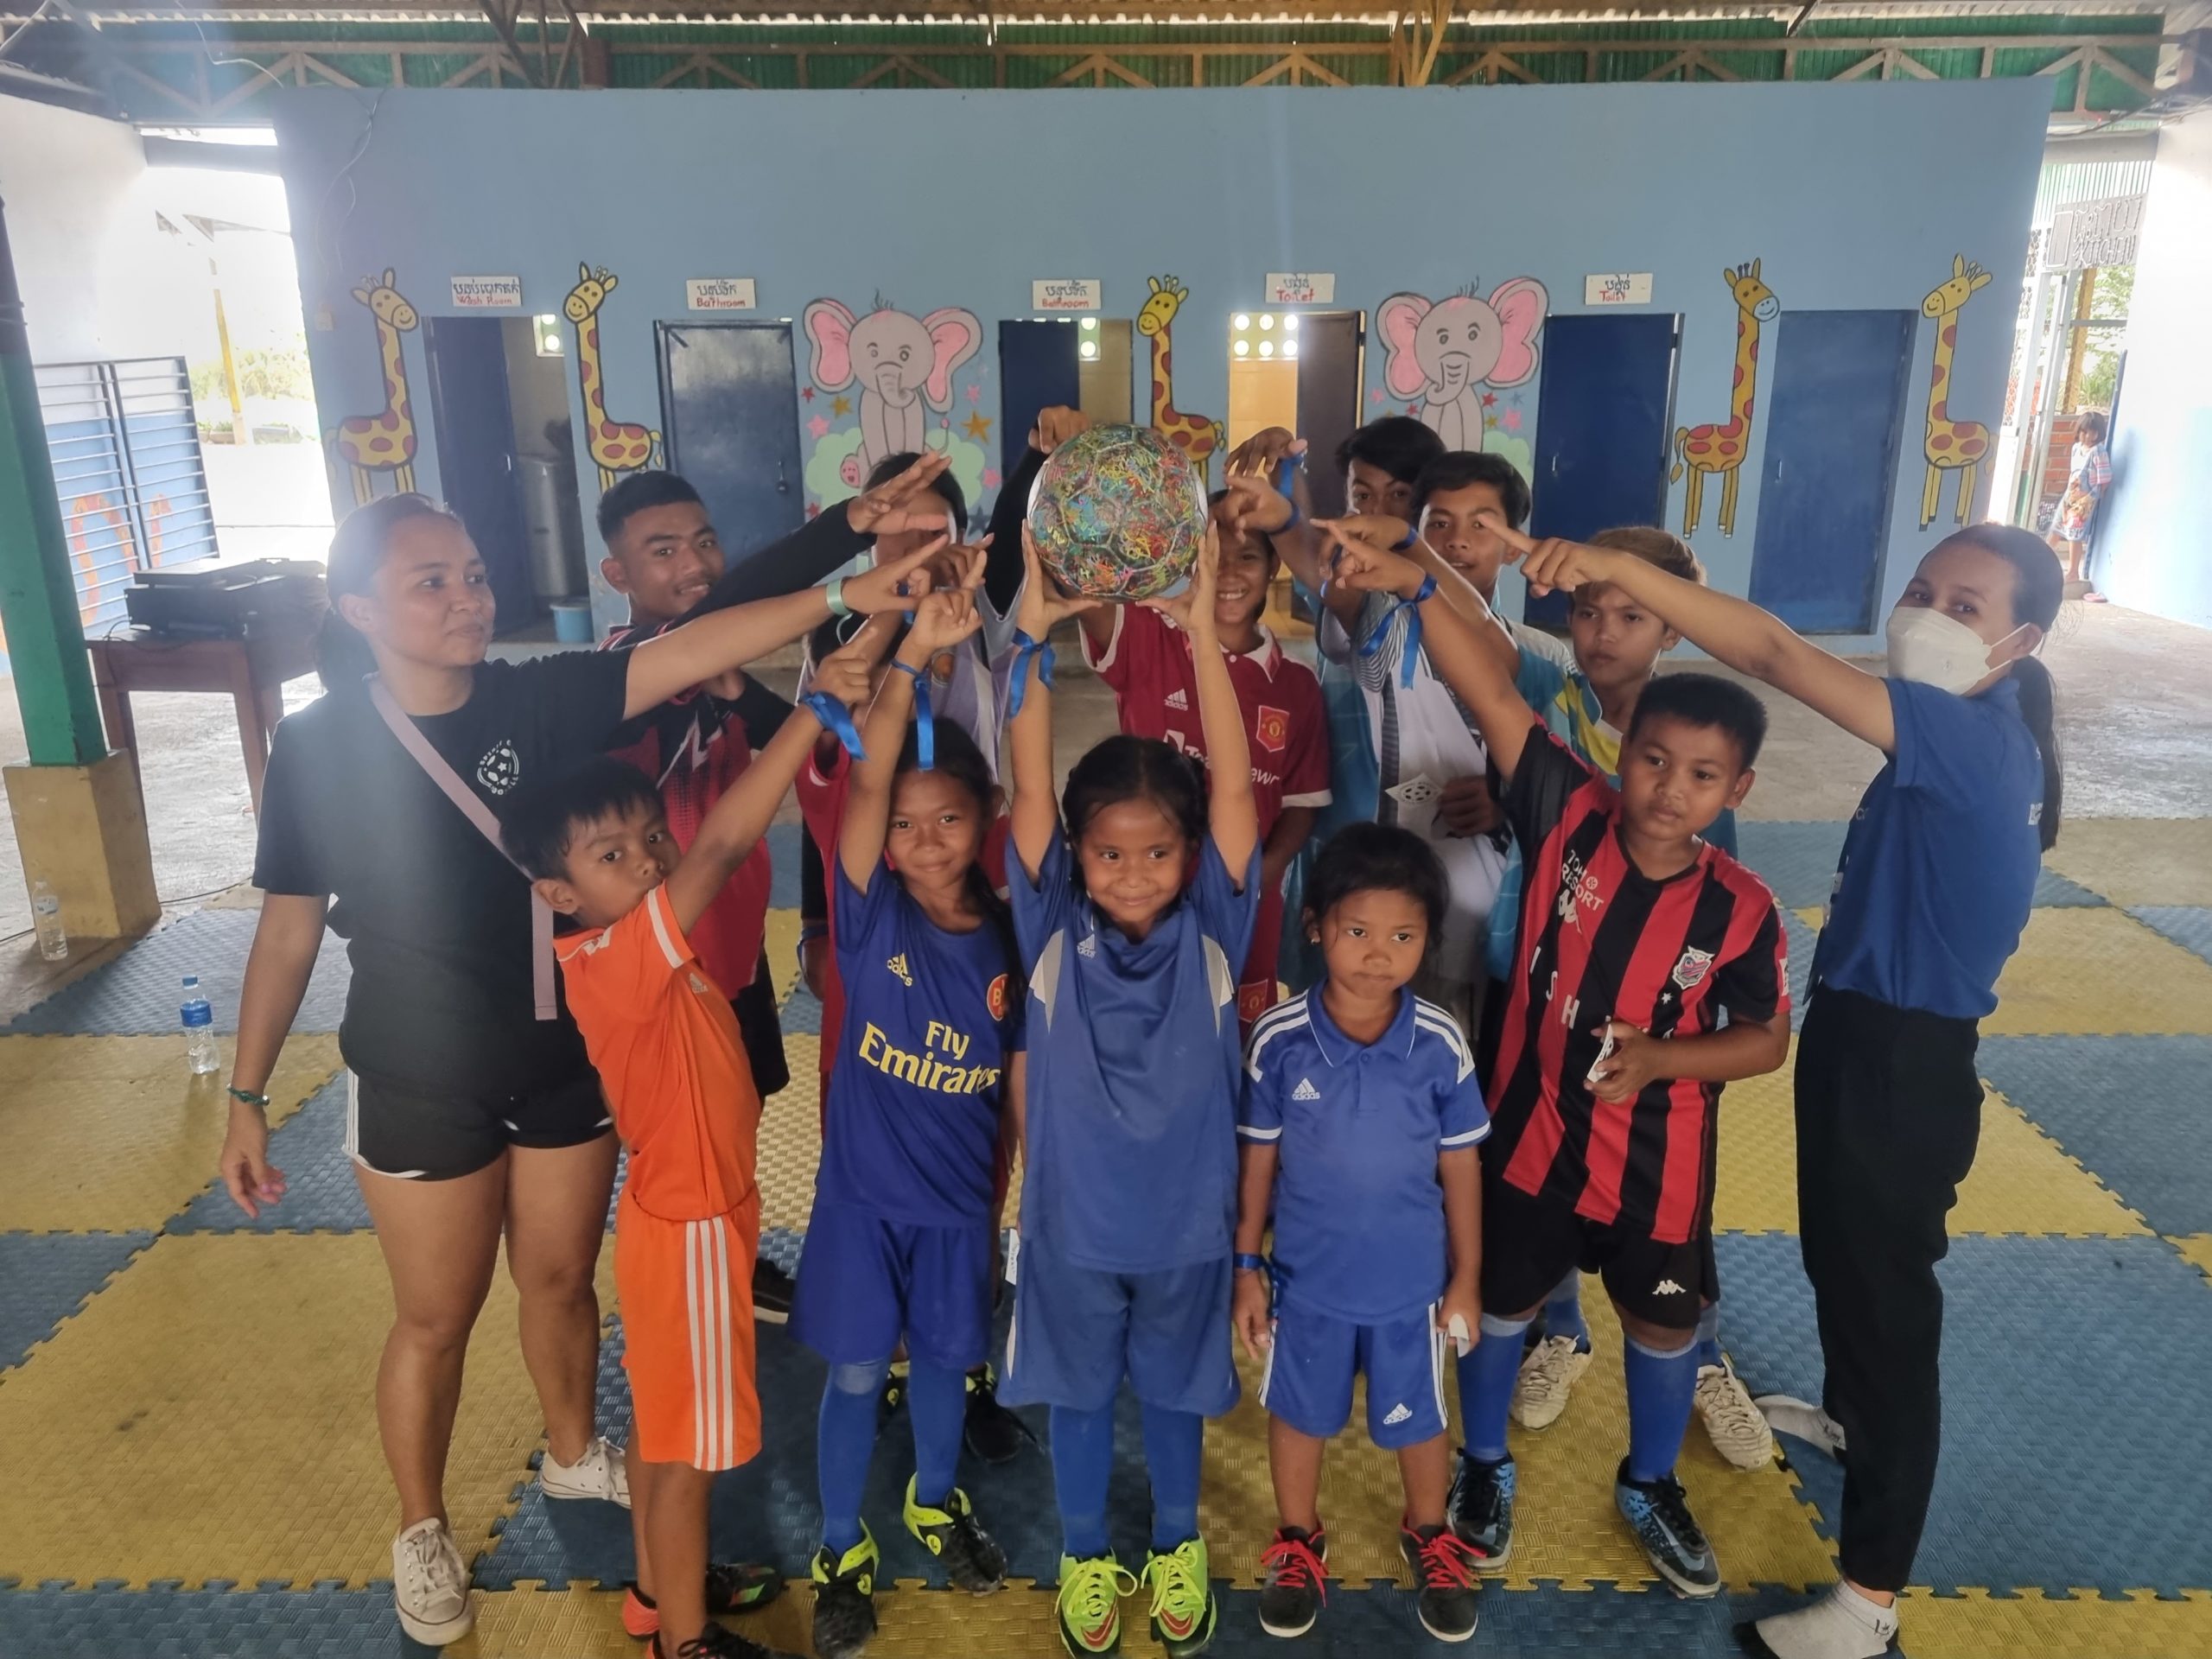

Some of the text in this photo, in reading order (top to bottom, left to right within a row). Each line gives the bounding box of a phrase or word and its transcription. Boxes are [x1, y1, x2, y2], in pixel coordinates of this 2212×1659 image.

[486, 296, 512, 305] Room
[696, 297, 746, 308] Bathroom
[1561, 862, 1605, 911] RESORT
[859, 1020, 1001, 1094] Emirates
[925, 1020, 969, 1060] Fly
